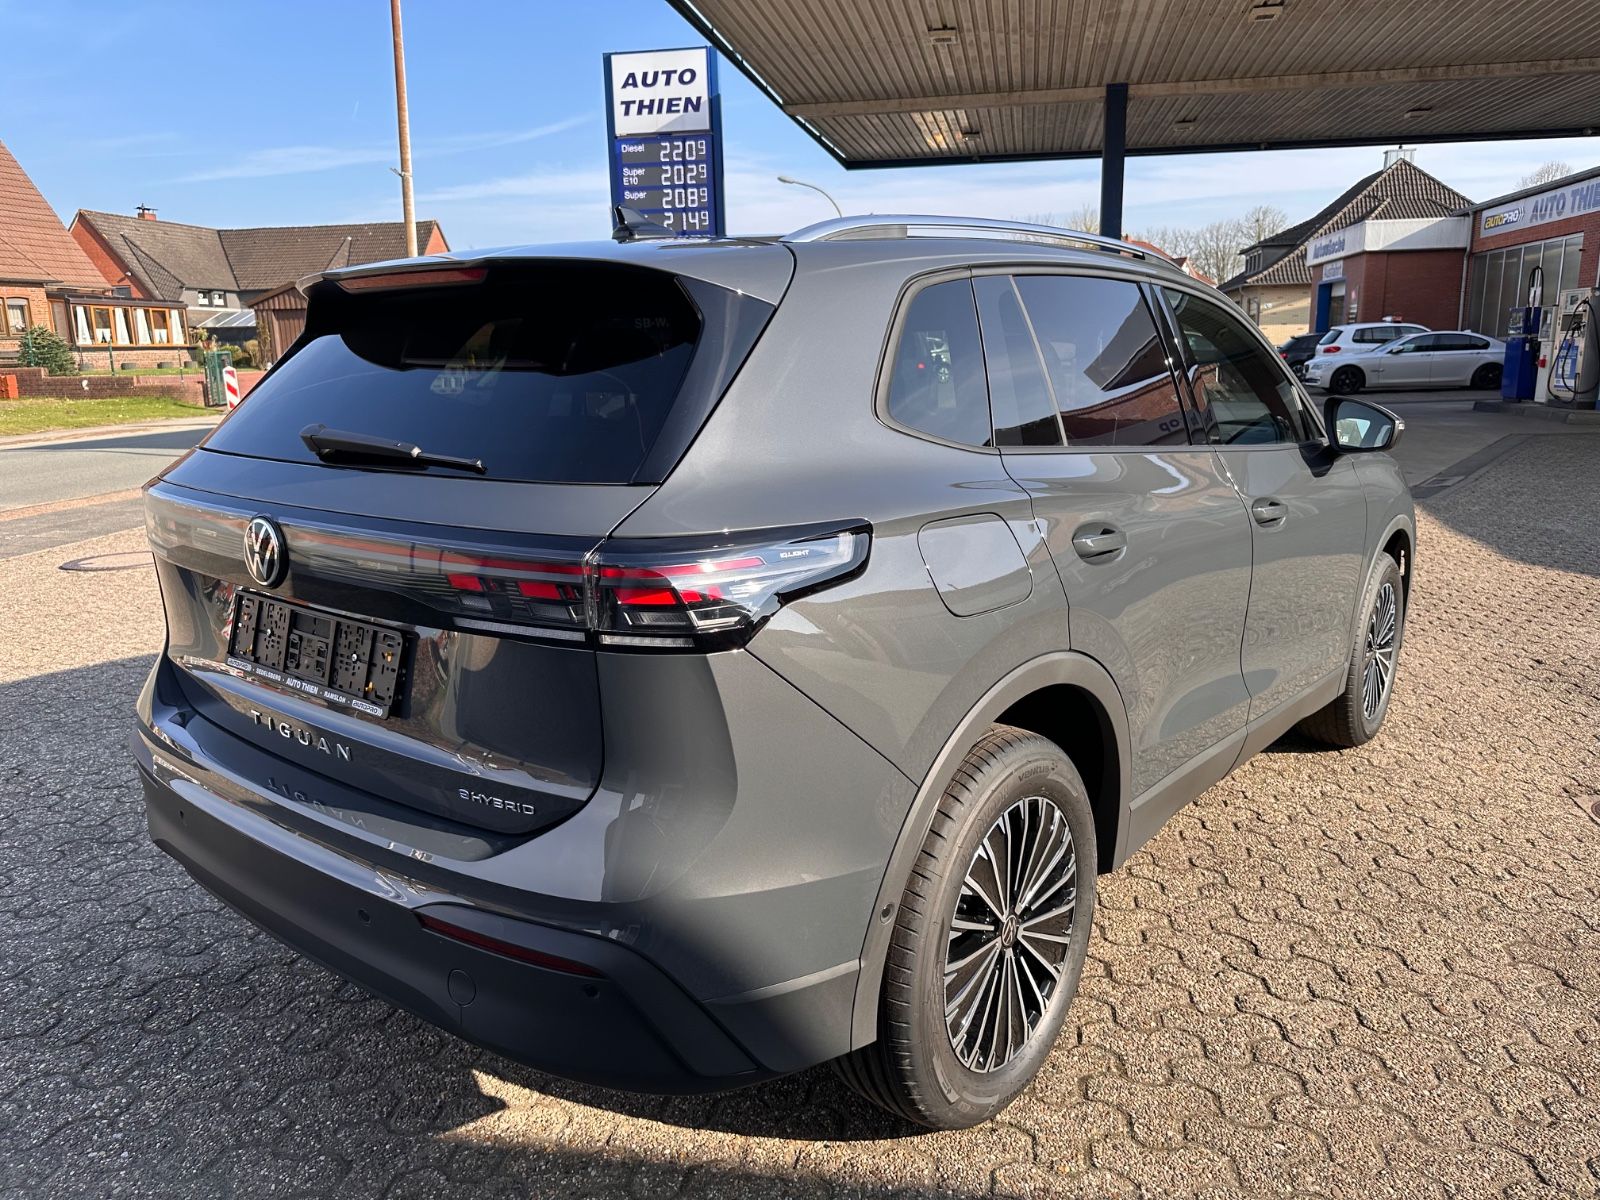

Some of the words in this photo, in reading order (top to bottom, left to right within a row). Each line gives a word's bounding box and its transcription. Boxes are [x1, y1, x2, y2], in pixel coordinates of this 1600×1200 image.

[621, 68, 697, 89] AUTO
[620, 96, 702, 116] THIEN
[621, 144, 645, 153] Diesel
[622, 168, 646, 177] Super
[623, 177, 639, 186] E10
[624, 191, 647, 201] Super
[1529, 192, 1567, 224] AUTO
[285, 677, 301, 689] AUTO
[301, 682, 319, 695] THIEN
[250, 709, 355, 763] TIGUAN
[458, 788, 536, 816] eHYBRID
